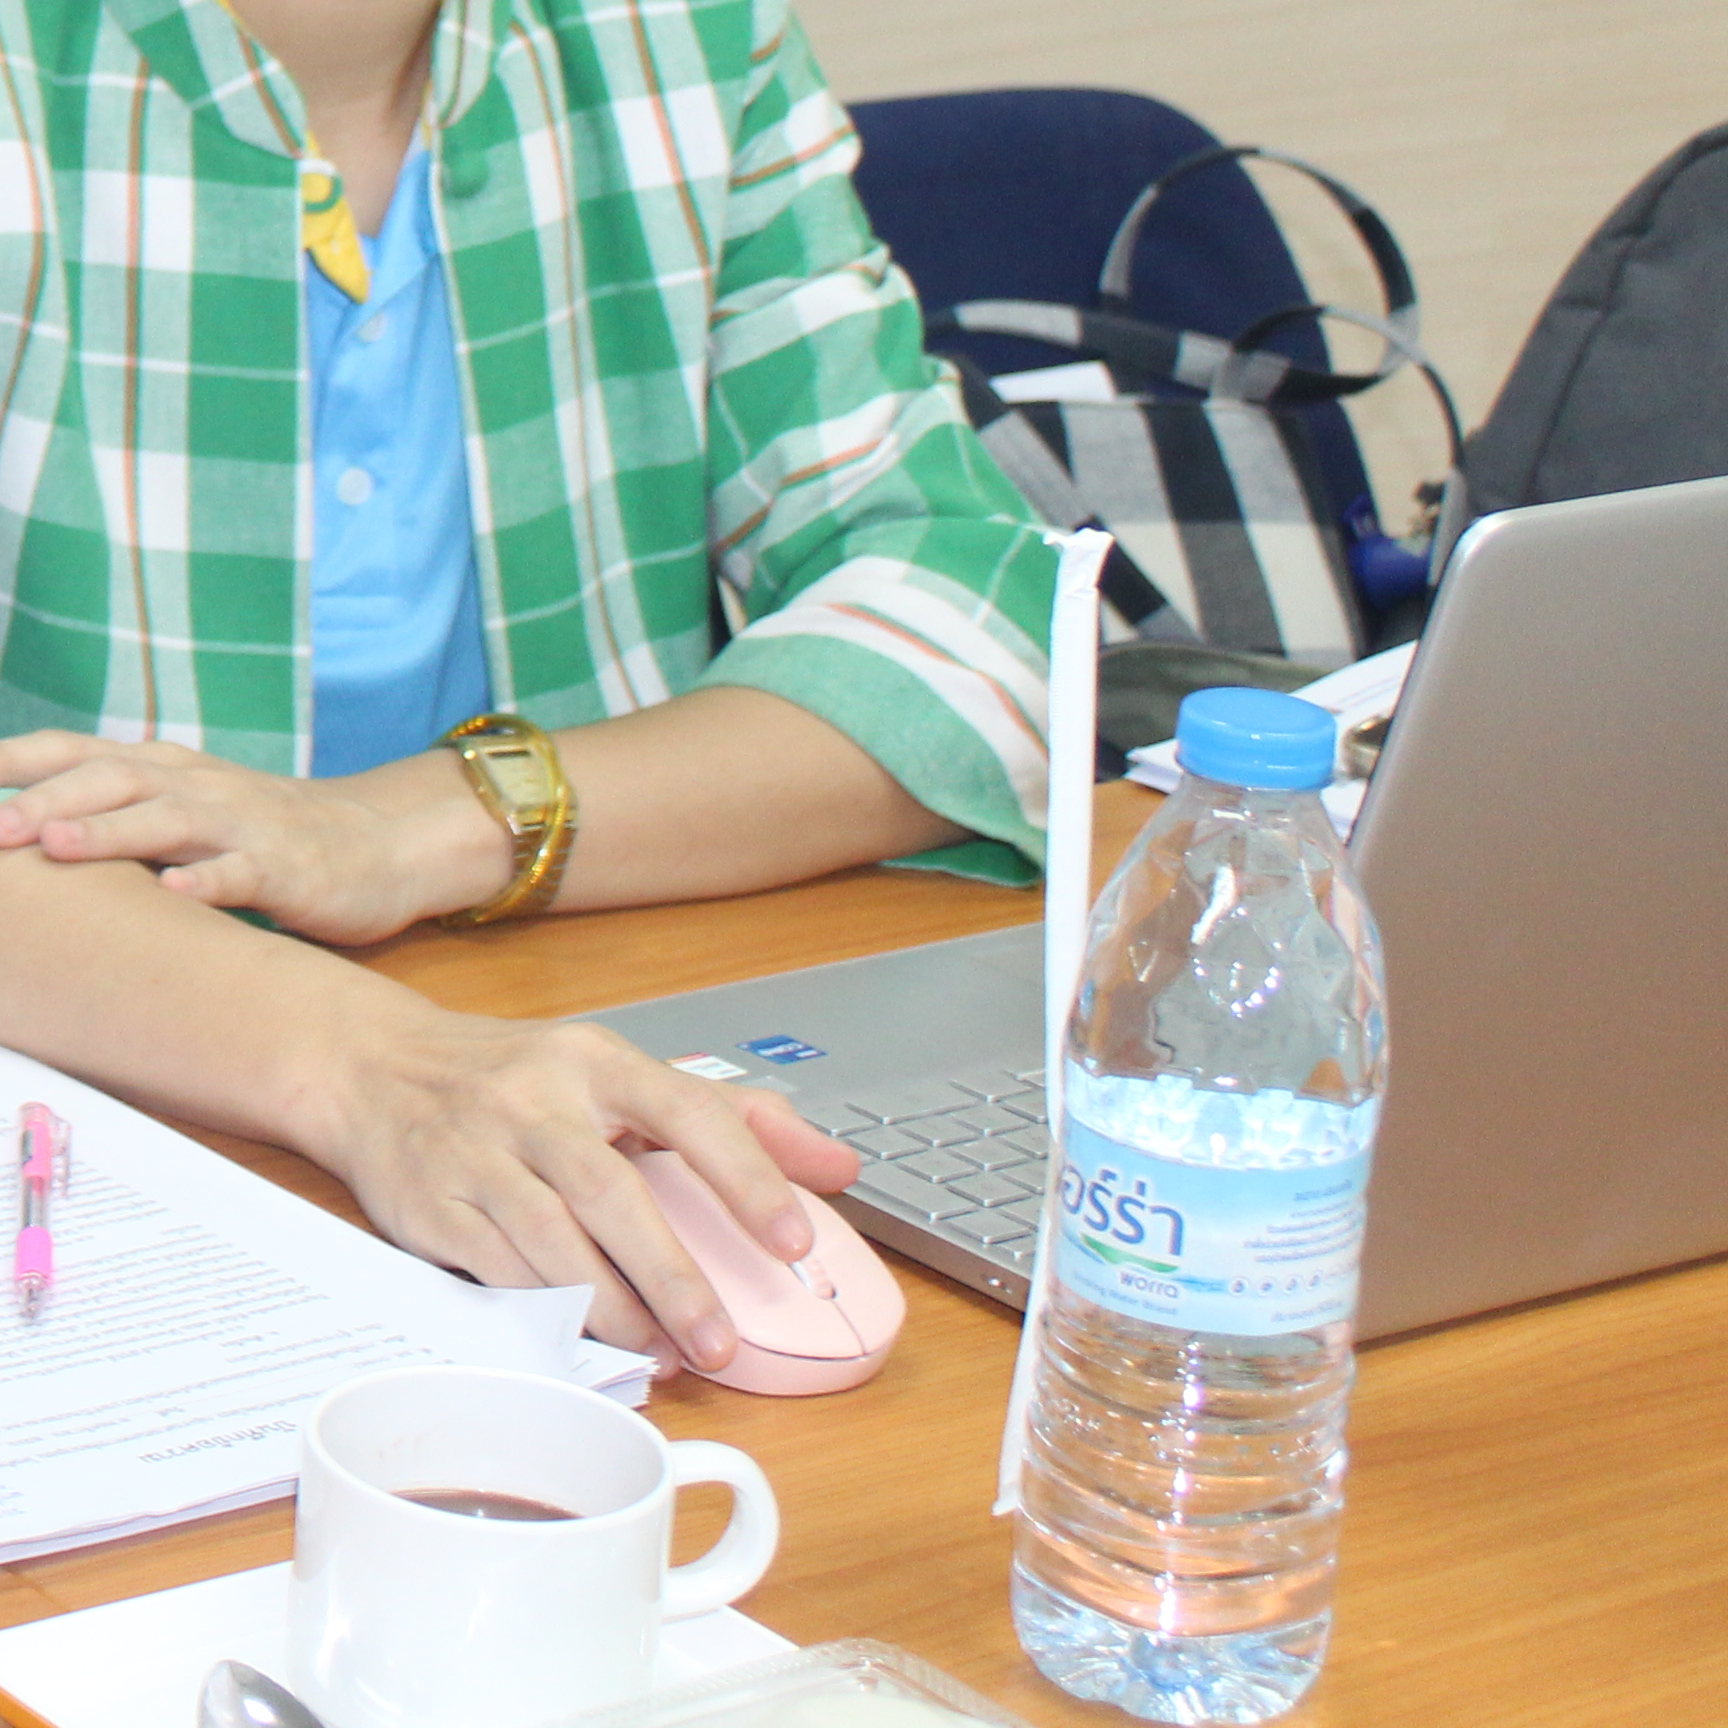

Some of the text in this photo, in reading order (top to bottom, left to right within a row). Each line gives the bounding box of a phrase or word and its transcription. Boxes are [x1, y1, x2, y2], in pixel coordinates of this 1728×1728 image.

[1060, 1164, 1184, 1256] อร์ร่า
[1119, 1271, 1179, 1299] worra
[137, 1419, 298, 1465] บันทึกข้อความ
